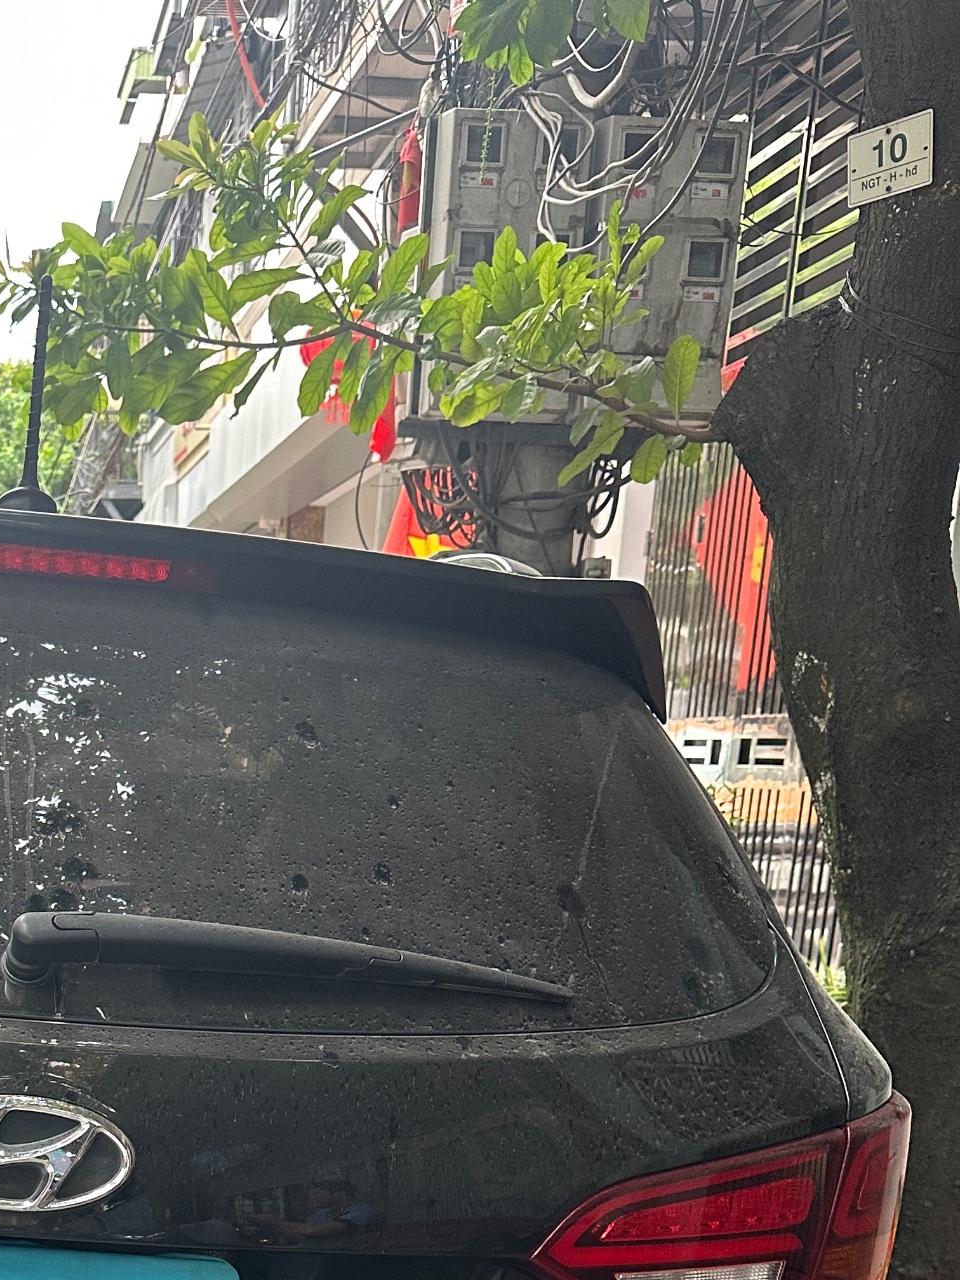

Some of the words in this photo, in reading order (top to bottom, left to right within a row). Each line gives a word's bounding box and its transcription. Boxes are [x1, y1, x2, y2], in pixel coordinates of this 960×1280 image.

[872, 133, 908, 168] 10
[861, 177, 882, 191] NGT
[890, 172, 897, 183] H
